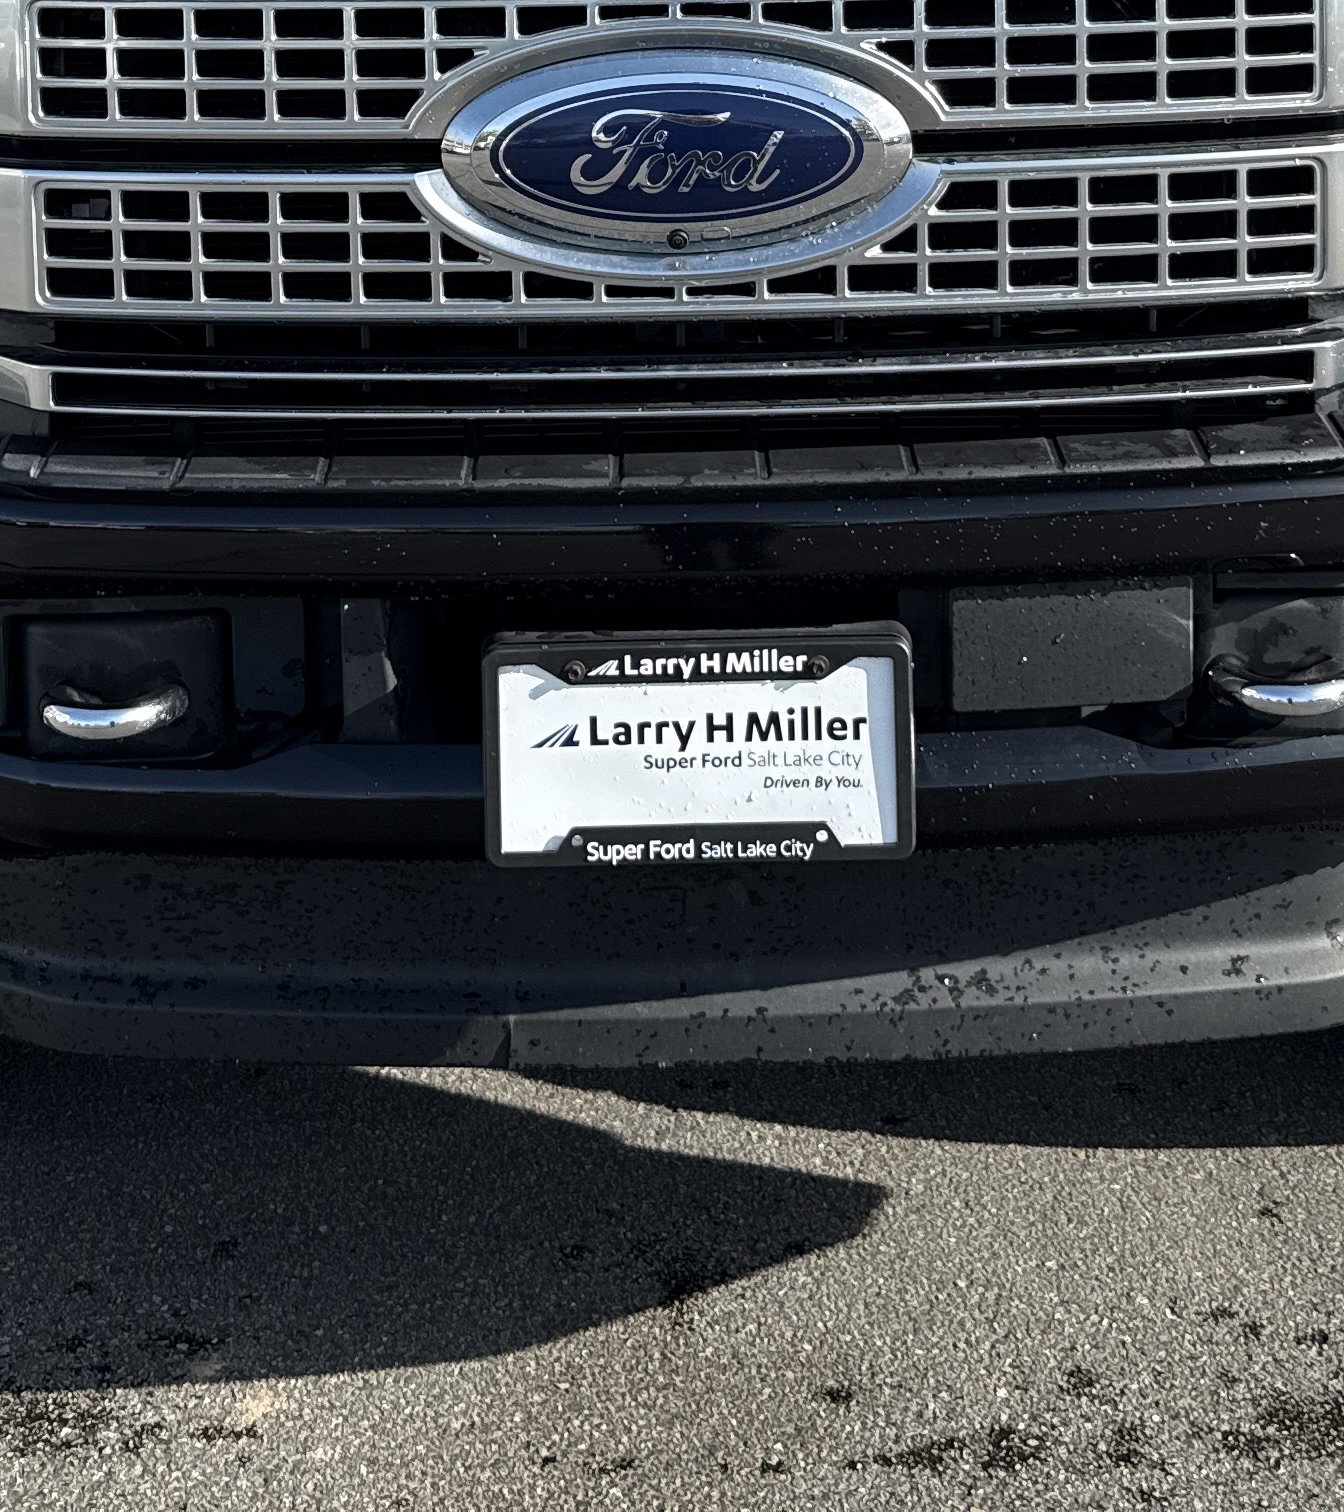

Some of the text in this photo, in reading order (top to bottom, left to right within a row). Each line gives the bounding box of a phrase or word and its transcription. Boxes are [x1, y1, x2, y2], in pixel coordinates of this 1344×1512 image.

[570, 109, 785, 195] Ford
[624, 649, 808, 679] Larry H Miller
[589, 705, 867, 752] Larry H Miller
[643, 750, 863, 773] Super Ford Salt Lake City
[763, 776, 809, 789] Driven
[814, 776, 832, 791] By
[586, 838, 814, 866] Super Ford Salt Lake City
